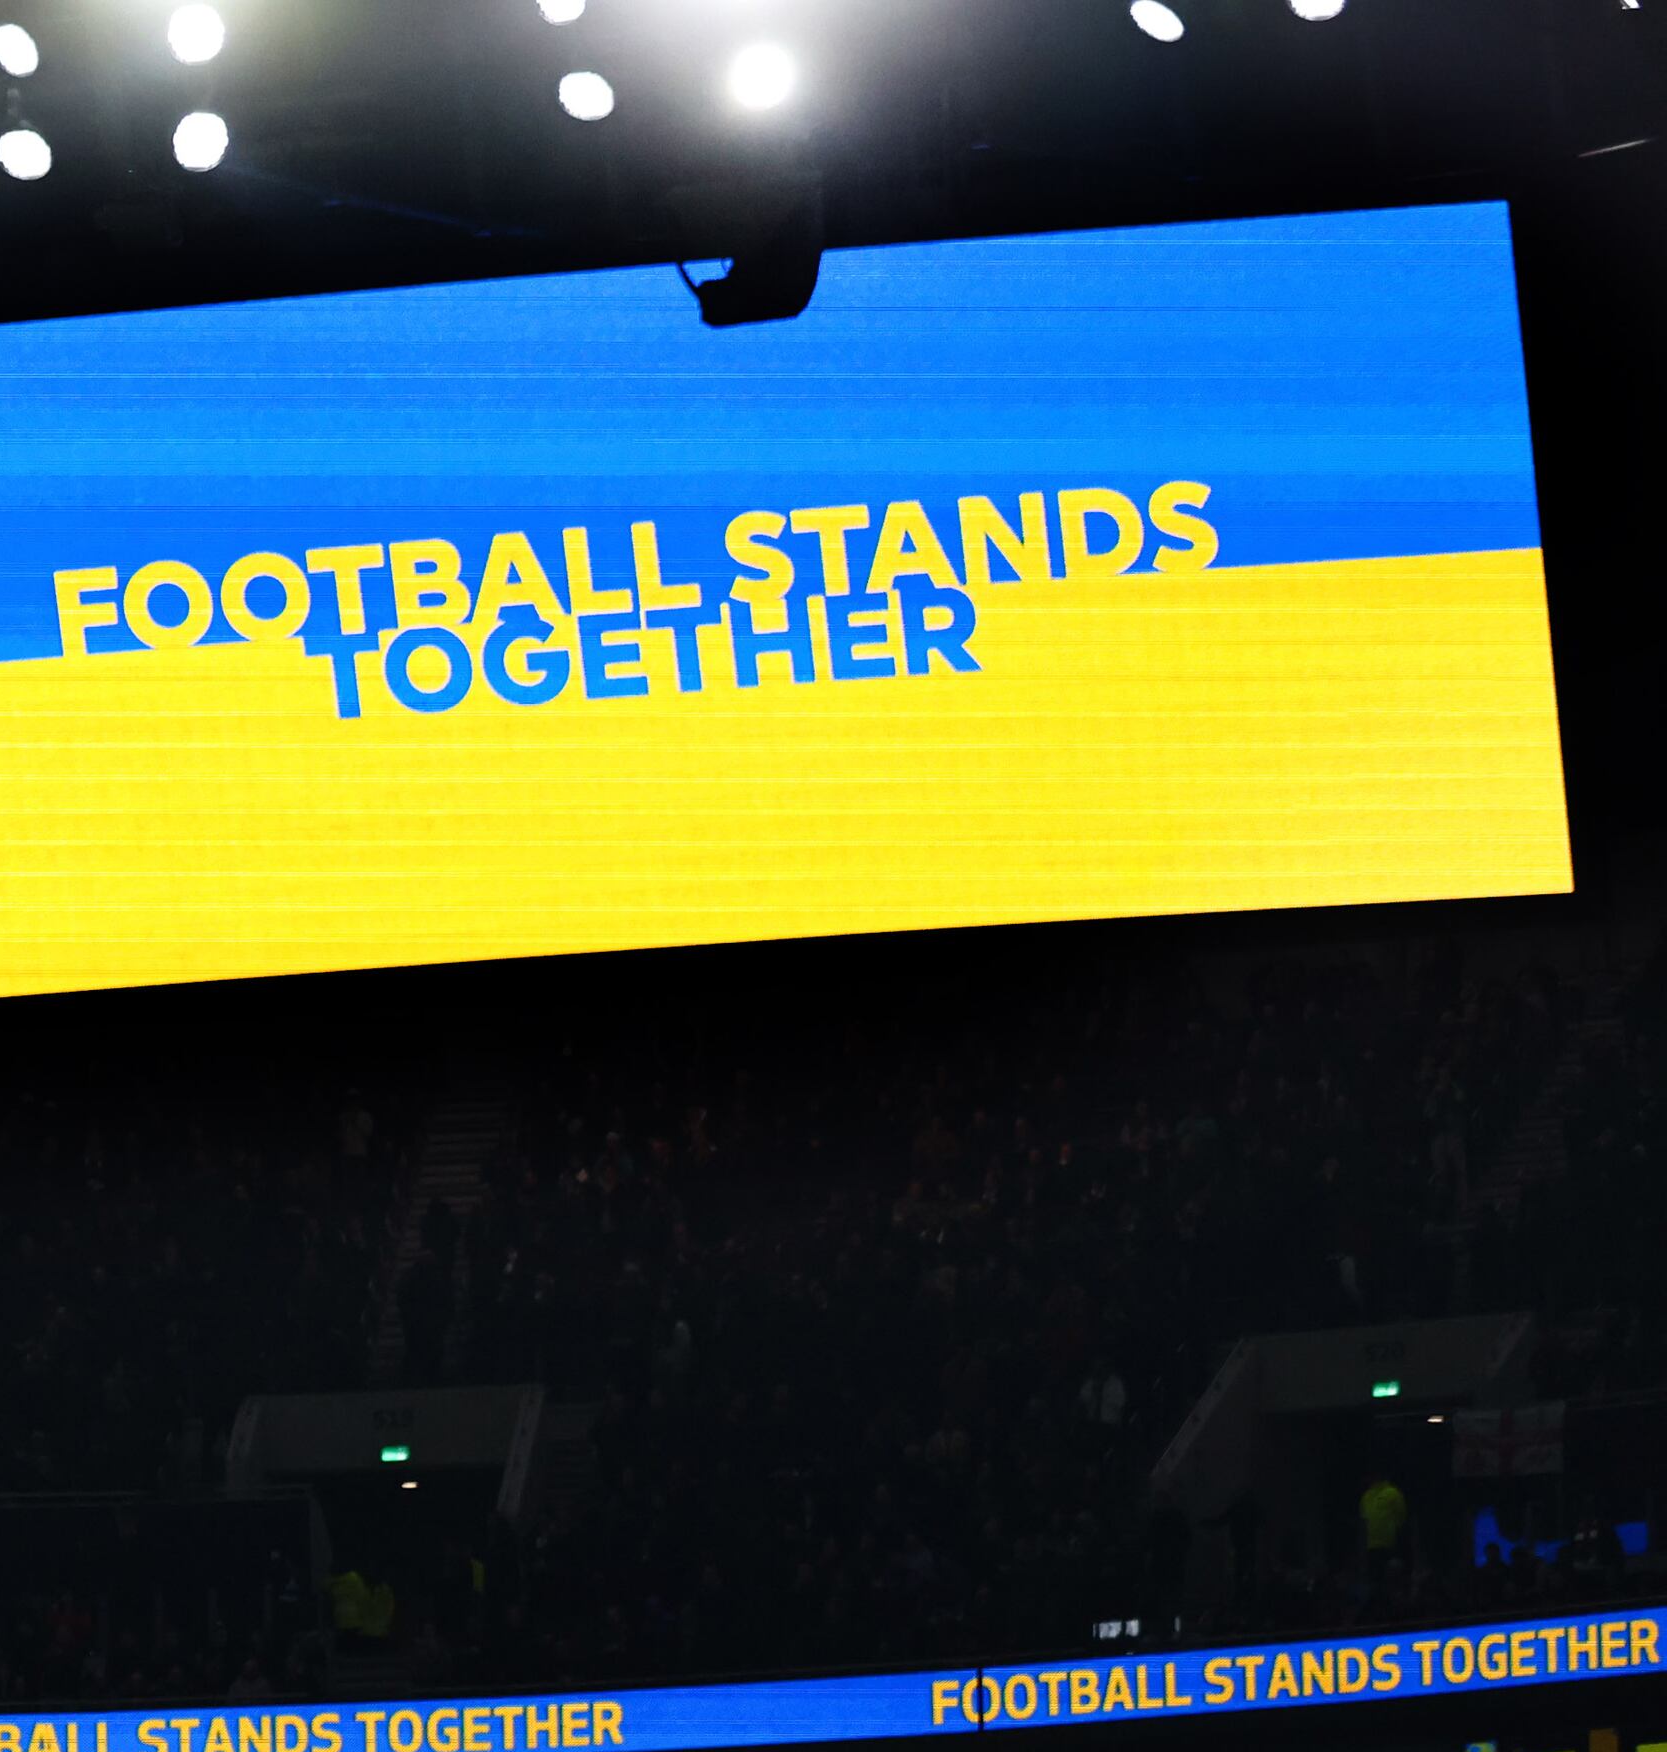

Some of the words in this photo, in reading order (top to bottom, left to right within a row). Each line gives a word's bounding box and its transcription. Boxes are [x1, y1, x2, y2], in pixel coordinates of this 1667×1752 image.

[54, 520, 701, 656] FOOTBALL
[725, 480, 1218, 603] STANDS
[301, 585, 982, 720] TOGETHER
[933, 1664, 1191, 1724] FOOTBALL
[1205, 1645, 1400, 1703] STANDS
[1414, 1620, 1659, 1684] TOGETHER
